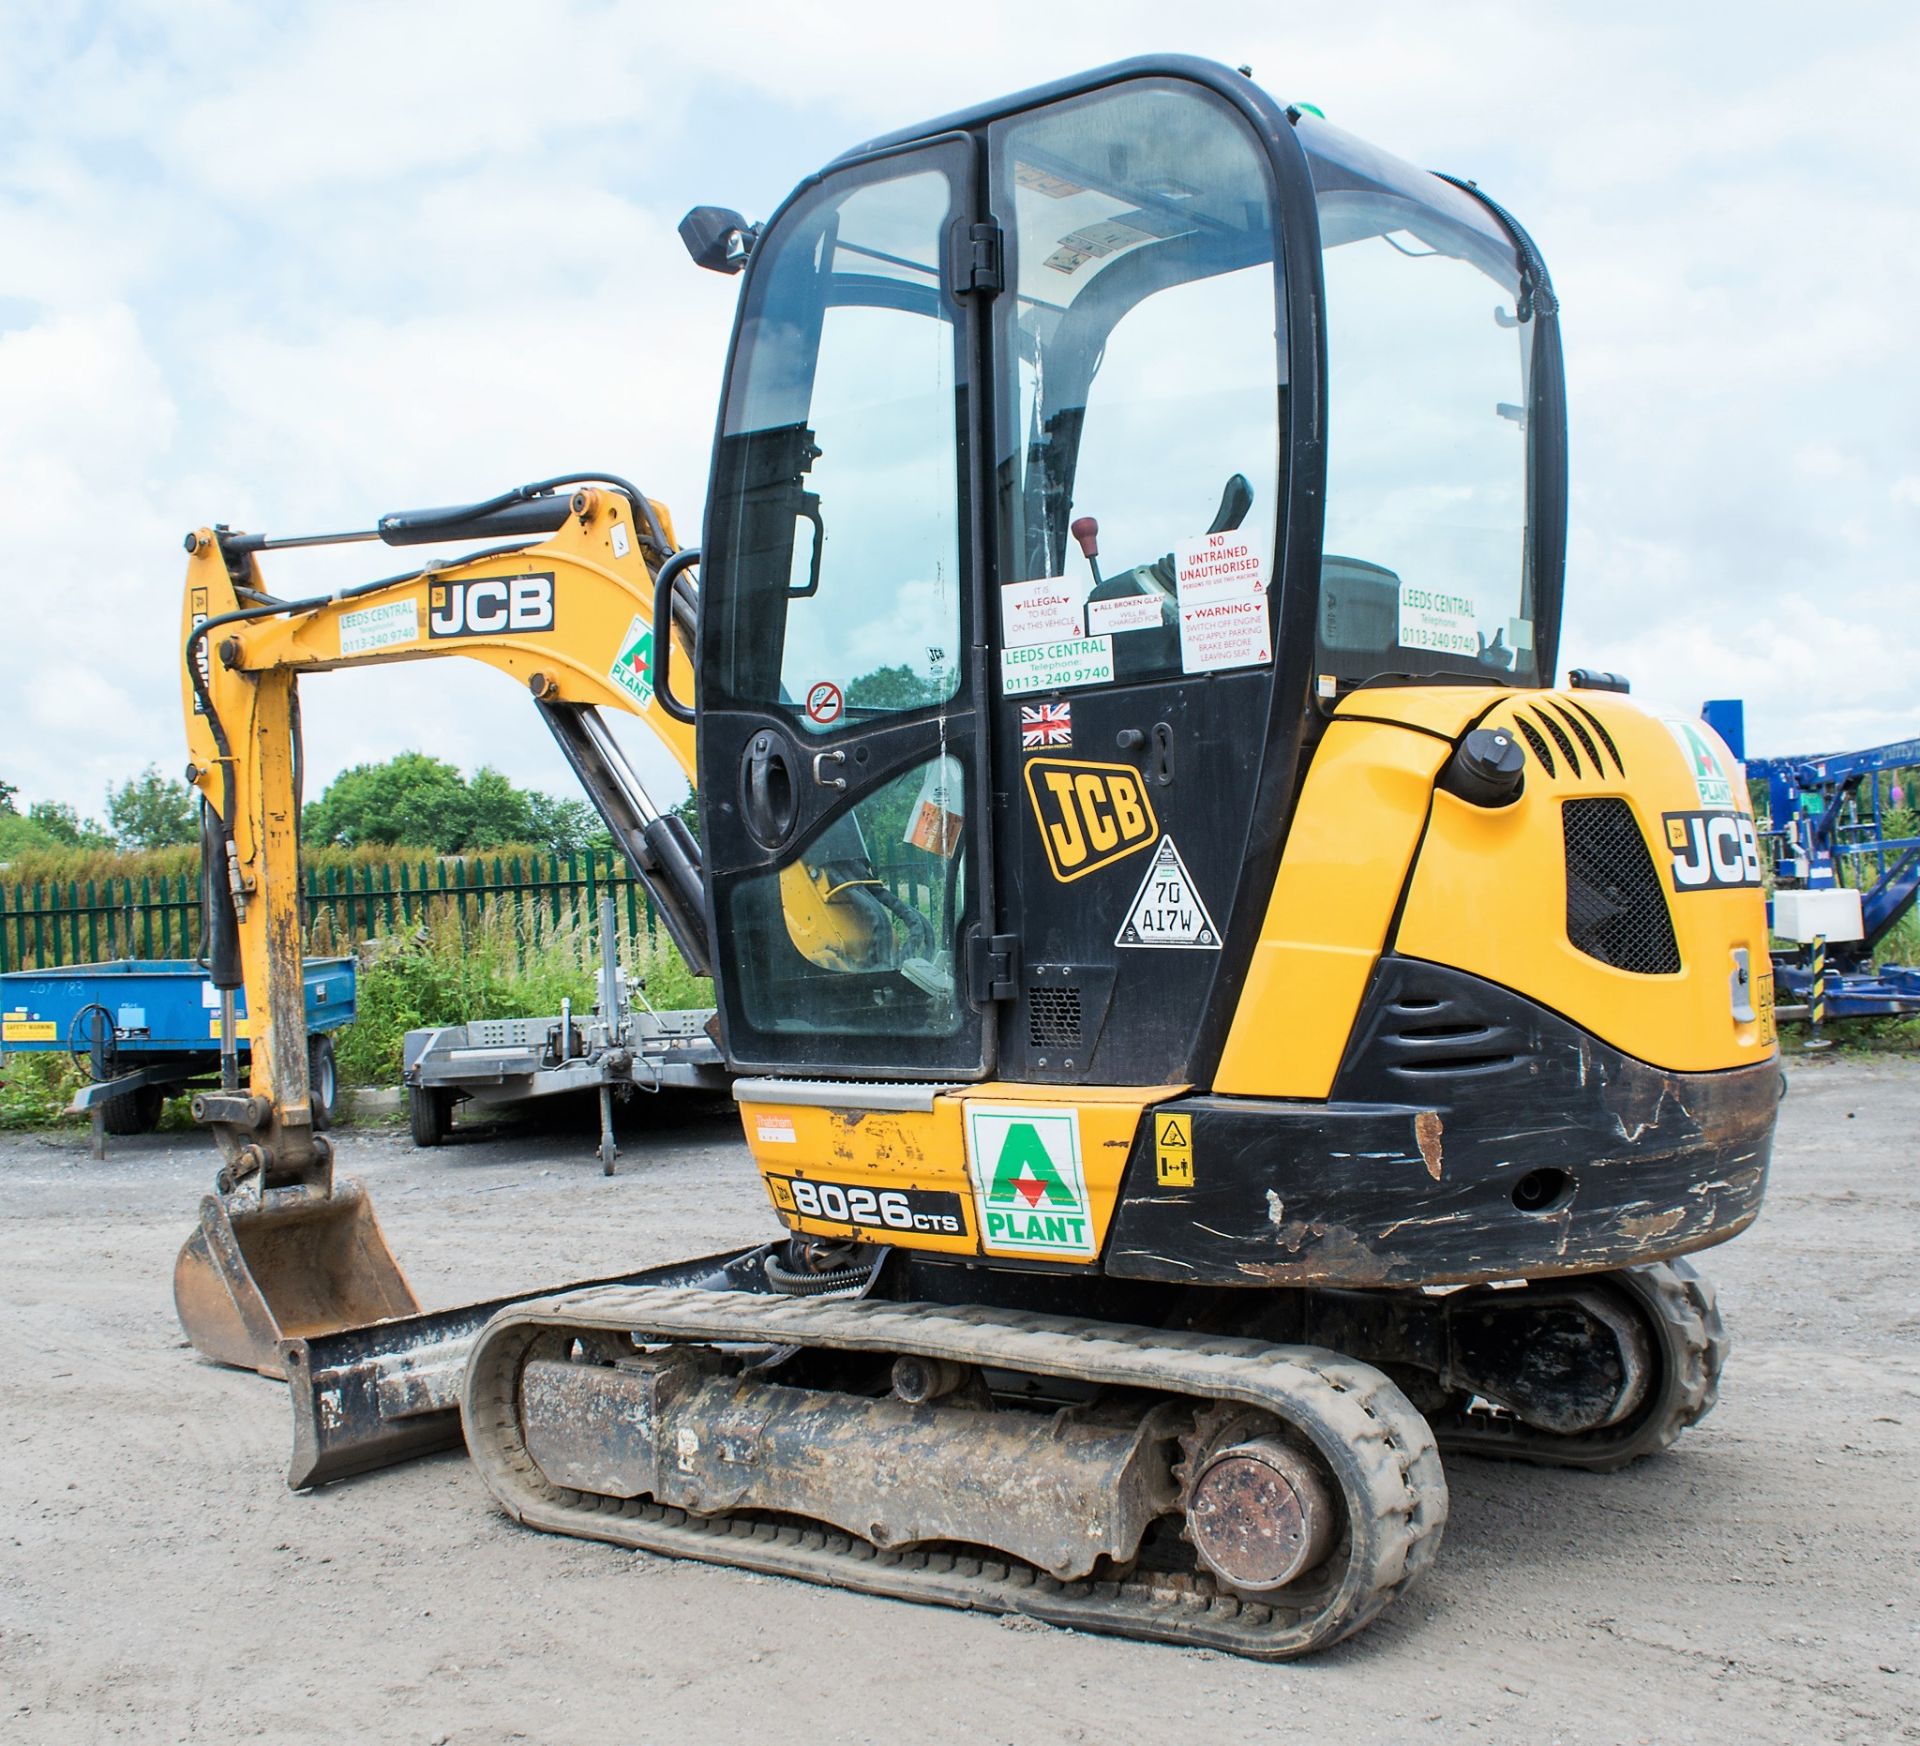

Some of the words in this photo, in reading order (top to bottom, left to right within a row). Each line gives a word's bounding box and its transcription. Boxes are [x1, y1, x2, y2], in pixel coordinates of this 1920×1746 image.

[1210, 536, 1224, 547] NO
[1189, 546, 1248, 566] UNTRAINED
[1180, 558, 1259, 581] UNAUTHORISED
[431, 578, 553, 634] JCB
[1023, 596, 1062, 608] ILLEGAL
[1100, 603, 1112, 611] ALL
[1114, 600, 1142, 608] BROKEN
[1195, 602, 1252, 618] WARNING
[1402, 588, 1432, 610] LEEDS
[1434, 594, 1476, 618] CENTRAL
[341, 612, 369, 629] LEEDS
[371, 602, 414, 622] CENTRAL
[1028, 610, 1039, 619] TO
[1041, 608, 1057, 617] RIDE
[1108, 616, 1144, 627] CHARGED
[1186, 621, 1216, 632] SWITCH
[1217, 619, 1231, 628] OFF
[1234, 616, 1262, 626] ENGINE
[1012, 624, 1025, 632] ON
[1028, 621, 1042, 630] THIS
[1045, 617, 1075, 628] VEHICLE
[1188, 634, 1204, 642] AND
[1206, 631, 1227, 640] APPLY
[1229, 626, 1262, 637] PARKING
[342, 632, 388, 652] 0113-240
[390, 626, 415, 642] 9740
[1199, 642, 1221, 652] BRAKE
[1224, 639, 1252, 648] BEFORE
[1402, 628, 1449, 648] 0113-240
[1452, 634, 1476, 652] 9740
[1006, 647, 1044, 665] LEEDS
[1048, 640, 1106, 659] CENTRAL
[1200, 651, 1232, 662] LEAVING
[1233, 649, 1251, 657] SEAT
[612, 663, 652, 704] PLANT
[1006, 671, 1071, 690] 0113-240
[1074, 666, 1109, 681] 9740
[1698, 782, 1731, 800] PLANT
[1044, 772, 1146, 867] JCB
[1674, 816, 1762, 885] JCB
[792, 1180, 913, 1228] 8026
[986, 1212, 1086, 1243] PLANT
